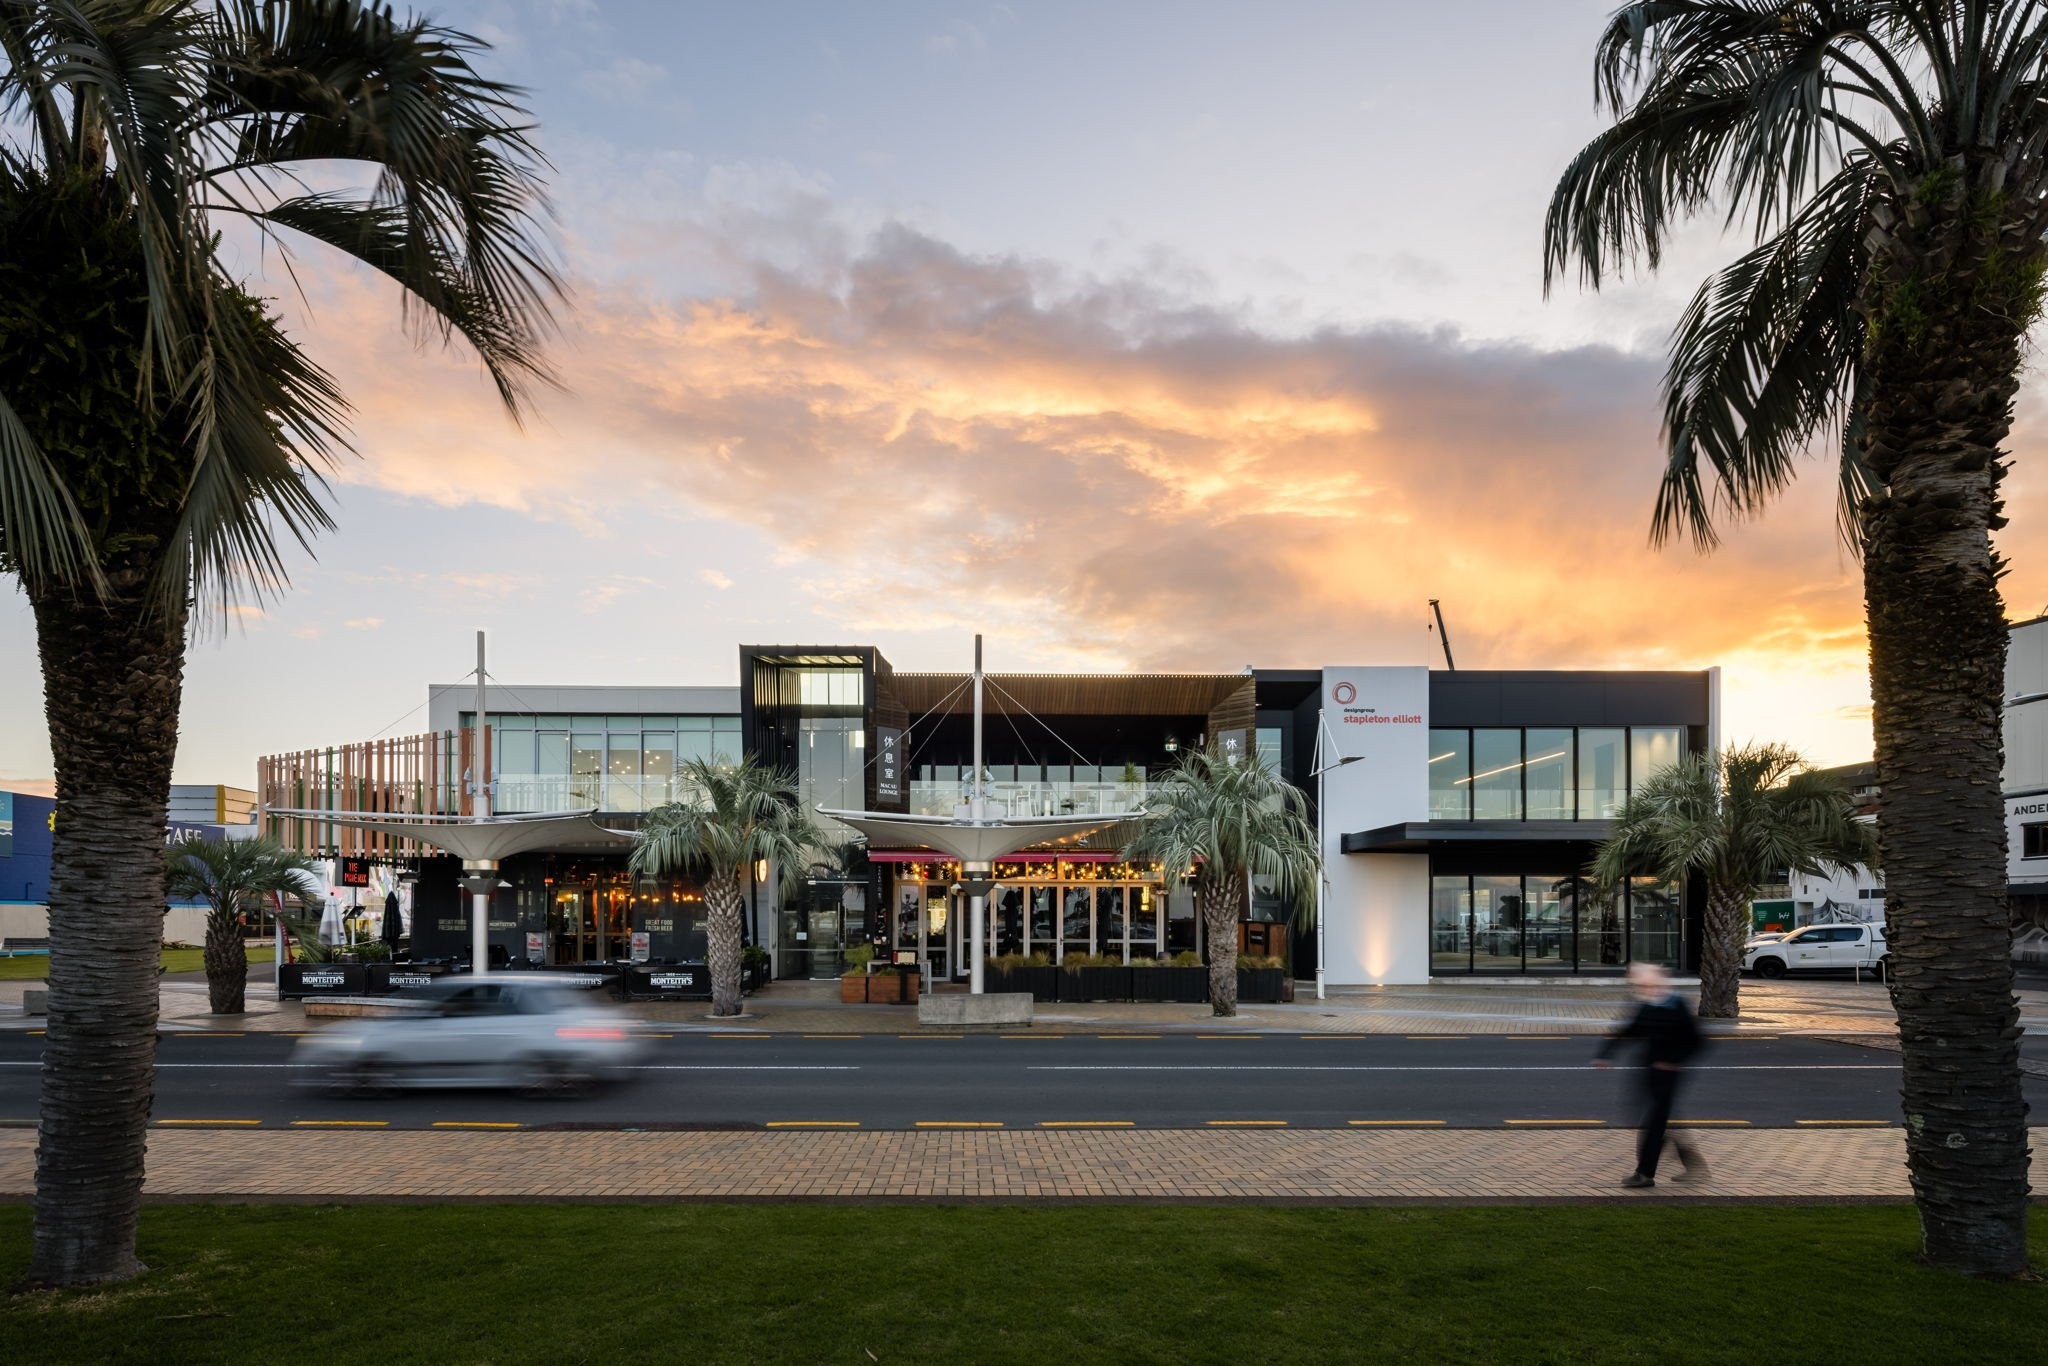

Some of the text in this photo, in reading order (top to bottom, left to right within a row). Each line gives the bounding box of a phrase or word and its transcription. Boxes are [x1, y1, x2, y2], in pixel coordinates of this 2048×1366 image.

[1344, 714, 1422, 725] stapleton elliott
[2014, 803, 2048, 815] ANDE
[302, 976, 345, 984] MONTEITH'S
[389, 977, 431, 985] MONTEITH'S
[650, 977, 693, 985] MONTEITH'S
